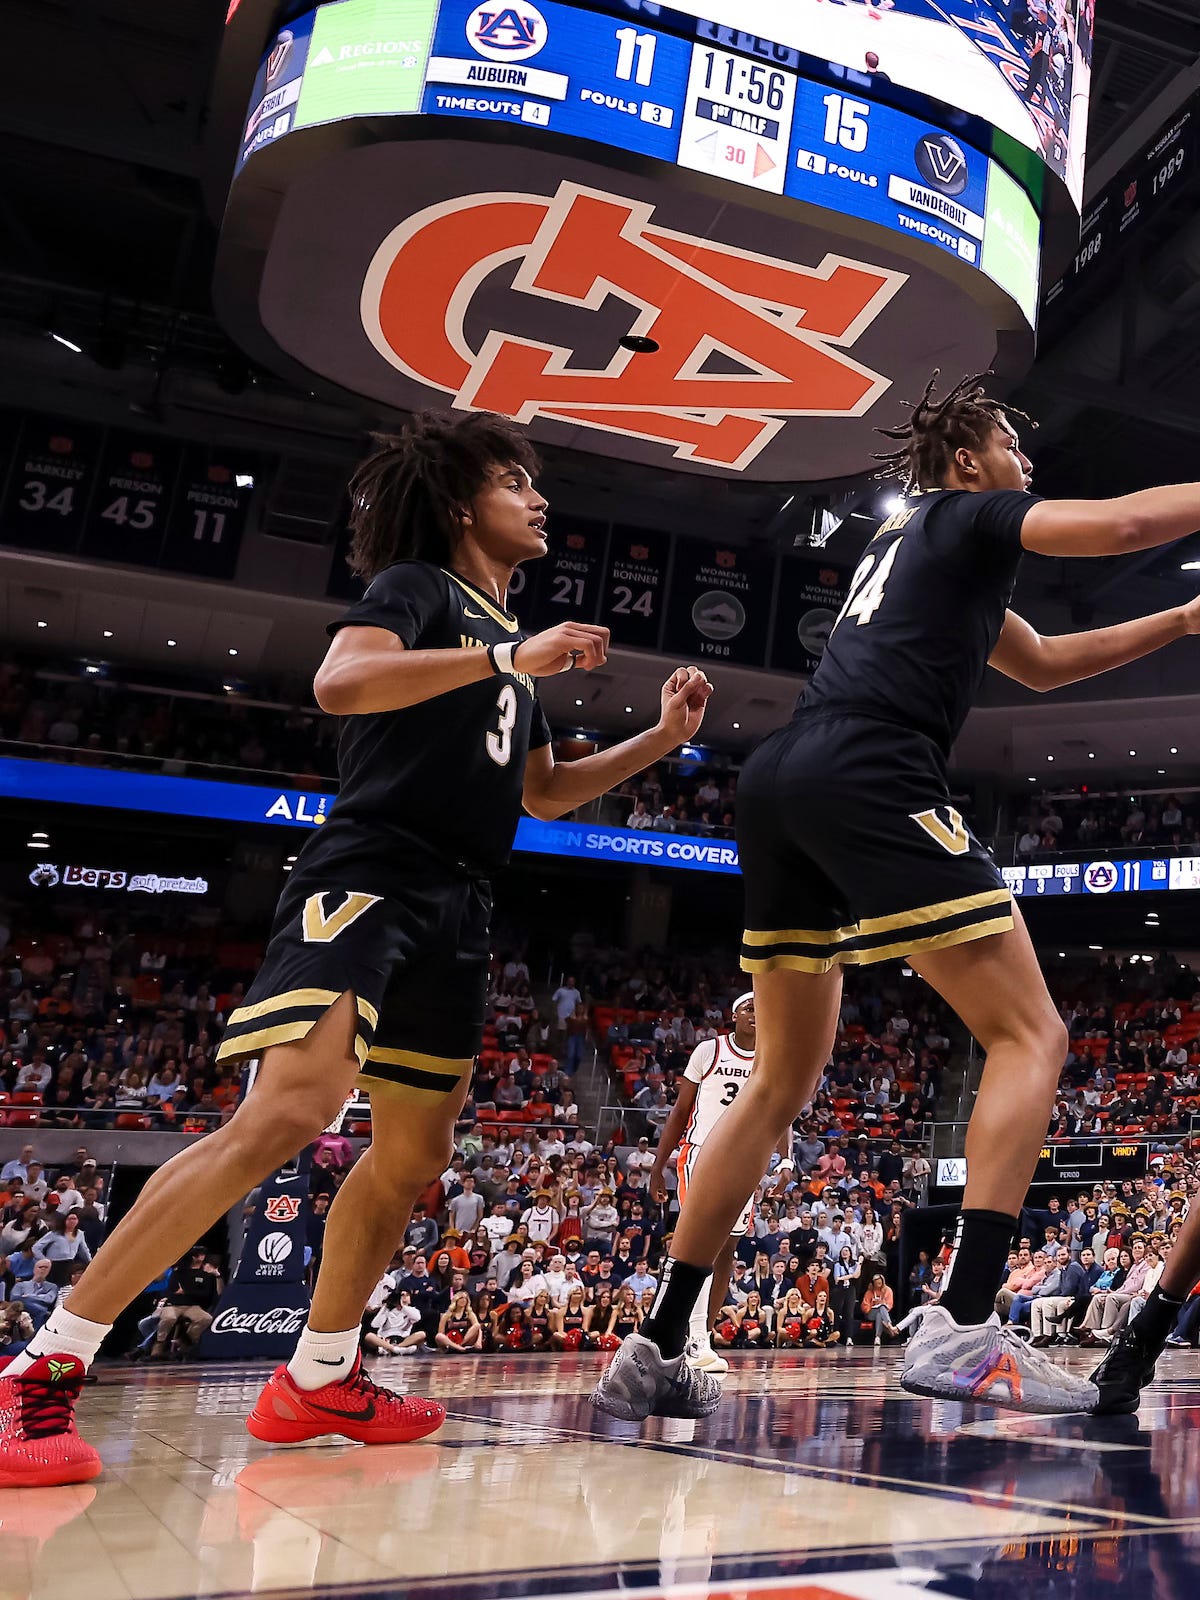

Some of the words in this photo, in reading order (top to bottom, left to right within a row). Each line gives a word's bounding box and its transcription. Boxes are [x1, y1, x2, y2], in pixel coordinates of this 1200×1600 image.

[338, 40, 423, 61] REGIONS
[614, 27, 657, 87] 11
[466, 64, 527, 88] AUBURN
[704, 52, 785, 112] 11:56
[436, 95, 522, 117] TIMEOUTS
[531, 107, 541, 120] 4
[580, 89, 638, 115] FOULS
[651, 107, 662, 122] 3
[731, 109, 767, 135] HALF
[822, 93, 869, 153] 15
[725, 145, 746, 165] 30
[806, 153, 816, 170] 4
[828, 163, 878, 189] FOULS
[1152, 149, 1184, 195] 1989
[909, 187, 967, 227] VANDERBILT
[898, 213, 959, 250] TIMEOUTS
[1074, 233, 1101, 274] 1988
[24, 461, 84, 480] BARKLEY
[109, 476, 163, 495] PERSON
[18, 480, 74, 517] 34
[186, 489, 239, 509] PERSON
[101, 496, 157, 530] 45
[192, 509, 227, 543] 11
[555, 560, 589, 573] JONES
[612, 569, 659, 586] BONNER
[700, 566, 748, 580] WOMEN'S
[549, 575, 585, 605] 21
[695, 573, 751, 591] BASKETBALL
[805, 584, 845, 598] WOMEN'
[611, 586, 654, 617] 24
[699, 642, 731, 656] 1988
[485, 684, 518, 767] 3
[585, 833, 664, 857] SPORTS
[1035, 868, 1048, 876] TO
[1057, 866, 1078, 876] FOULS
[1122, 861, 1141, 892] 11
[132, 875, 157, 890] soft
[158, 877, 207, 893] pretzels
[1036, 878, 1045, 894] 3
[1063, 876, 1072, 893] 3
[719, 1082, 740, 1107] 3
[1112, 1147, 1138, 1157] VANDY
[1060, 1171, 1080, 1179] PERIOD
[255, 1269, 285, 1277] CREEK
[259, 1263, 284, 1271] WIND
[210, 1306, 309, 1334] Coca-Cola
